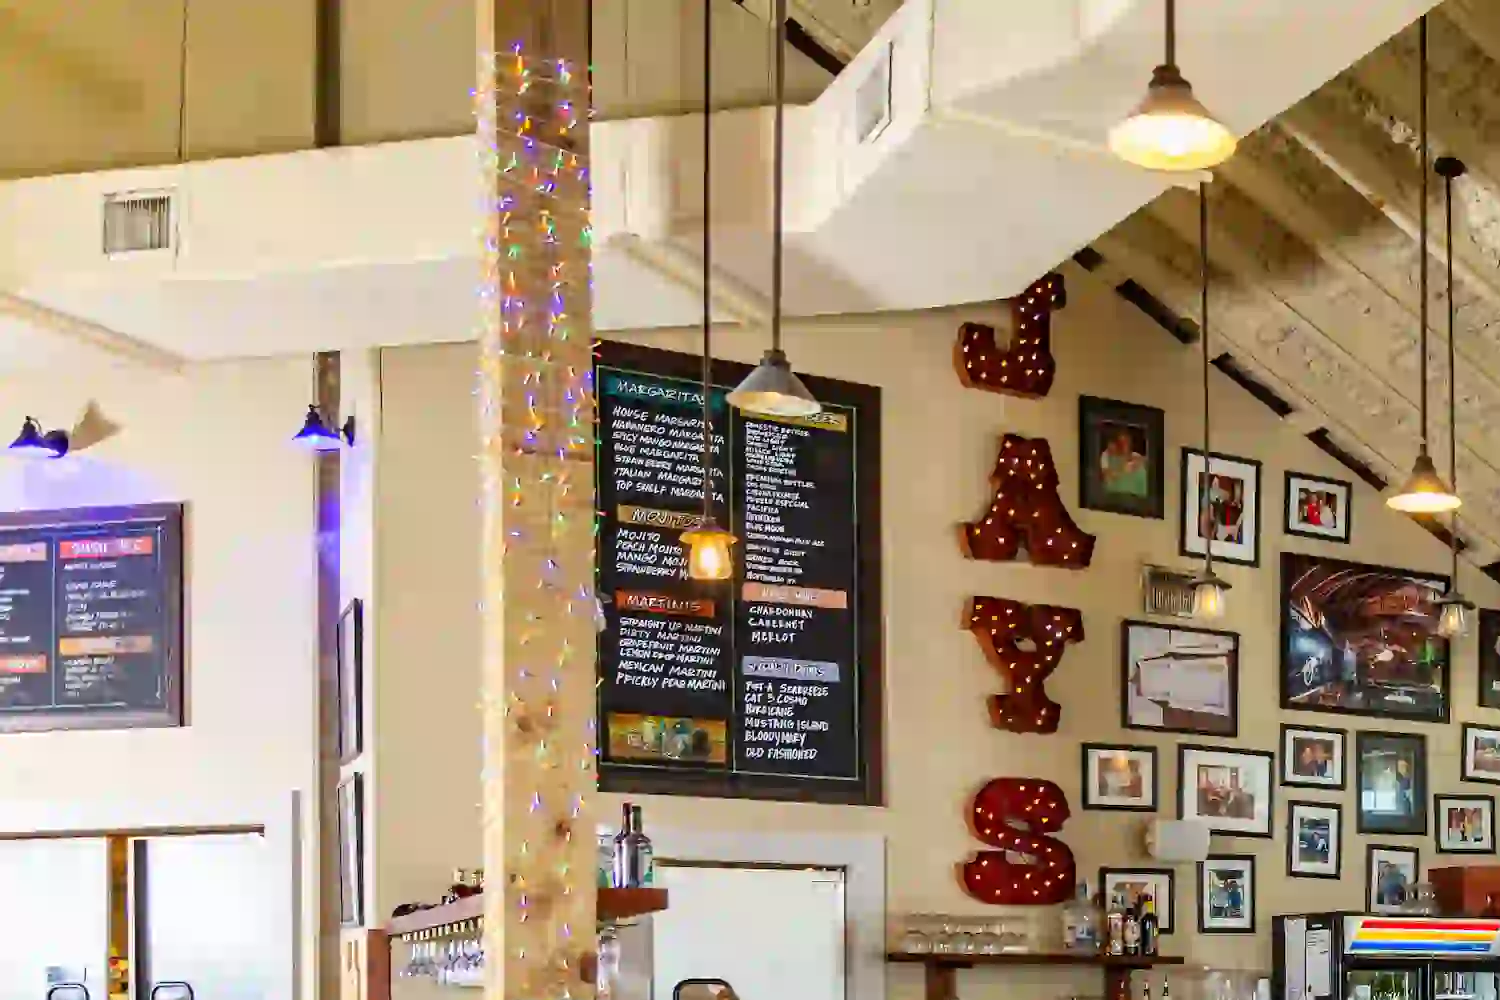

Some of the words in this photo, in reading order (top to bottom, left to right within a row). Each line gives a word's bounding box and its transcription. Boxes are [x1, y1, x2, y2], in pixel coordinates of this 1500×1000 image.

[612, 405, 649, 422] HOUSE
[612, 419, 666, 435] HABANERO
[669, 427, 725, 445] MARGAITA
[614, 467, 652, 479] ITALIAN
[676, 463, 724, 479] MARGAITA
[616, 480, 633, 492] TOP
[636, 483, 668, 496] SHELF
[616, 527, 661, 543] MOJITO
[616, 539, 647, 553] PEACH
[616, 552, 658, 564] MANGO
[615, 562, 677, 577] STRAWBERRY
[626, 595, 702, 612] MARTINIS
[748, 605, 813, 619] CHARDONNAY
[619, 616, 667, 631] STRAIGHT
[747, 617, 806, 631] CABERNET
[619, 627, 652, 640] DIRTY
[751, 631, 798, 644] MERLOT
[619, 647, 650, 659] LEMON
[678, 643, 721, 657] MARTINI
[617, 659, 665, 674] MEXICAN
[668, 664, 718, 679] MARTINI
[615, 671, 660, 689] PRICKLY
[686, 679, 727, 693] MARTINI
[744, 716, 795, 730] MUSTANG
[743, 730, 780, 746] BLOODY
[745, 746, 766, 759] OLD
